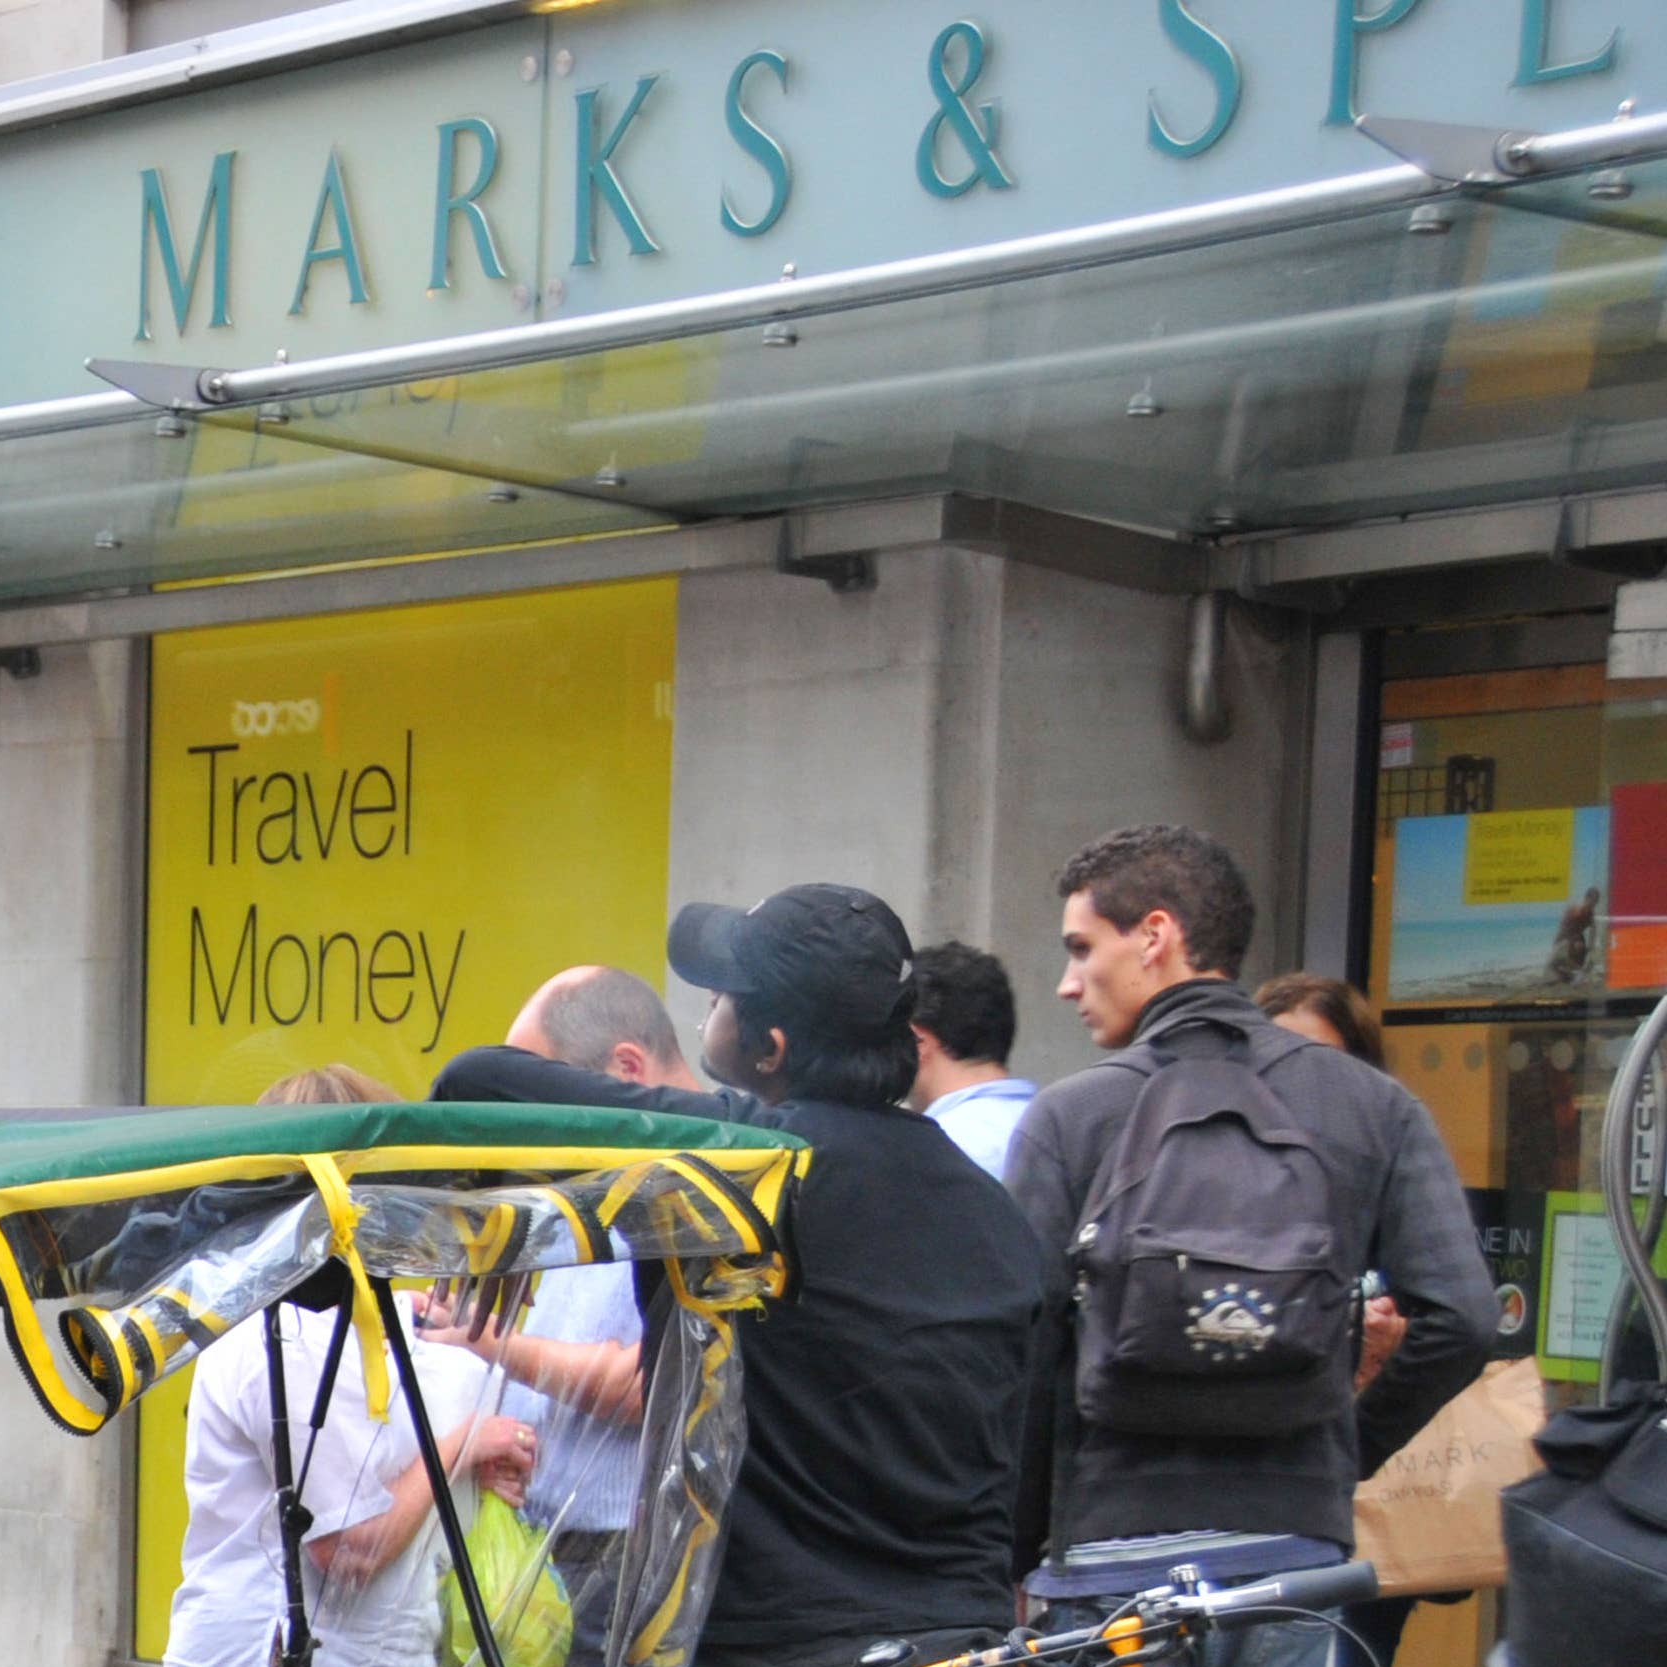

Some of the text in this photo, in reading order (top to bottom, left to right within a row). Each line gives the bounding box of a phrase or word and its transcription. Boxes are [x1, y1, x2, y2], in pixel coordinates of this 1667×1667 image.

[133, 48, 796, 343] MARKS
[916, 19, 1017, 199] &
[187, 729, 412, 865] Travel
[189, 903, 466, 1053] Money
